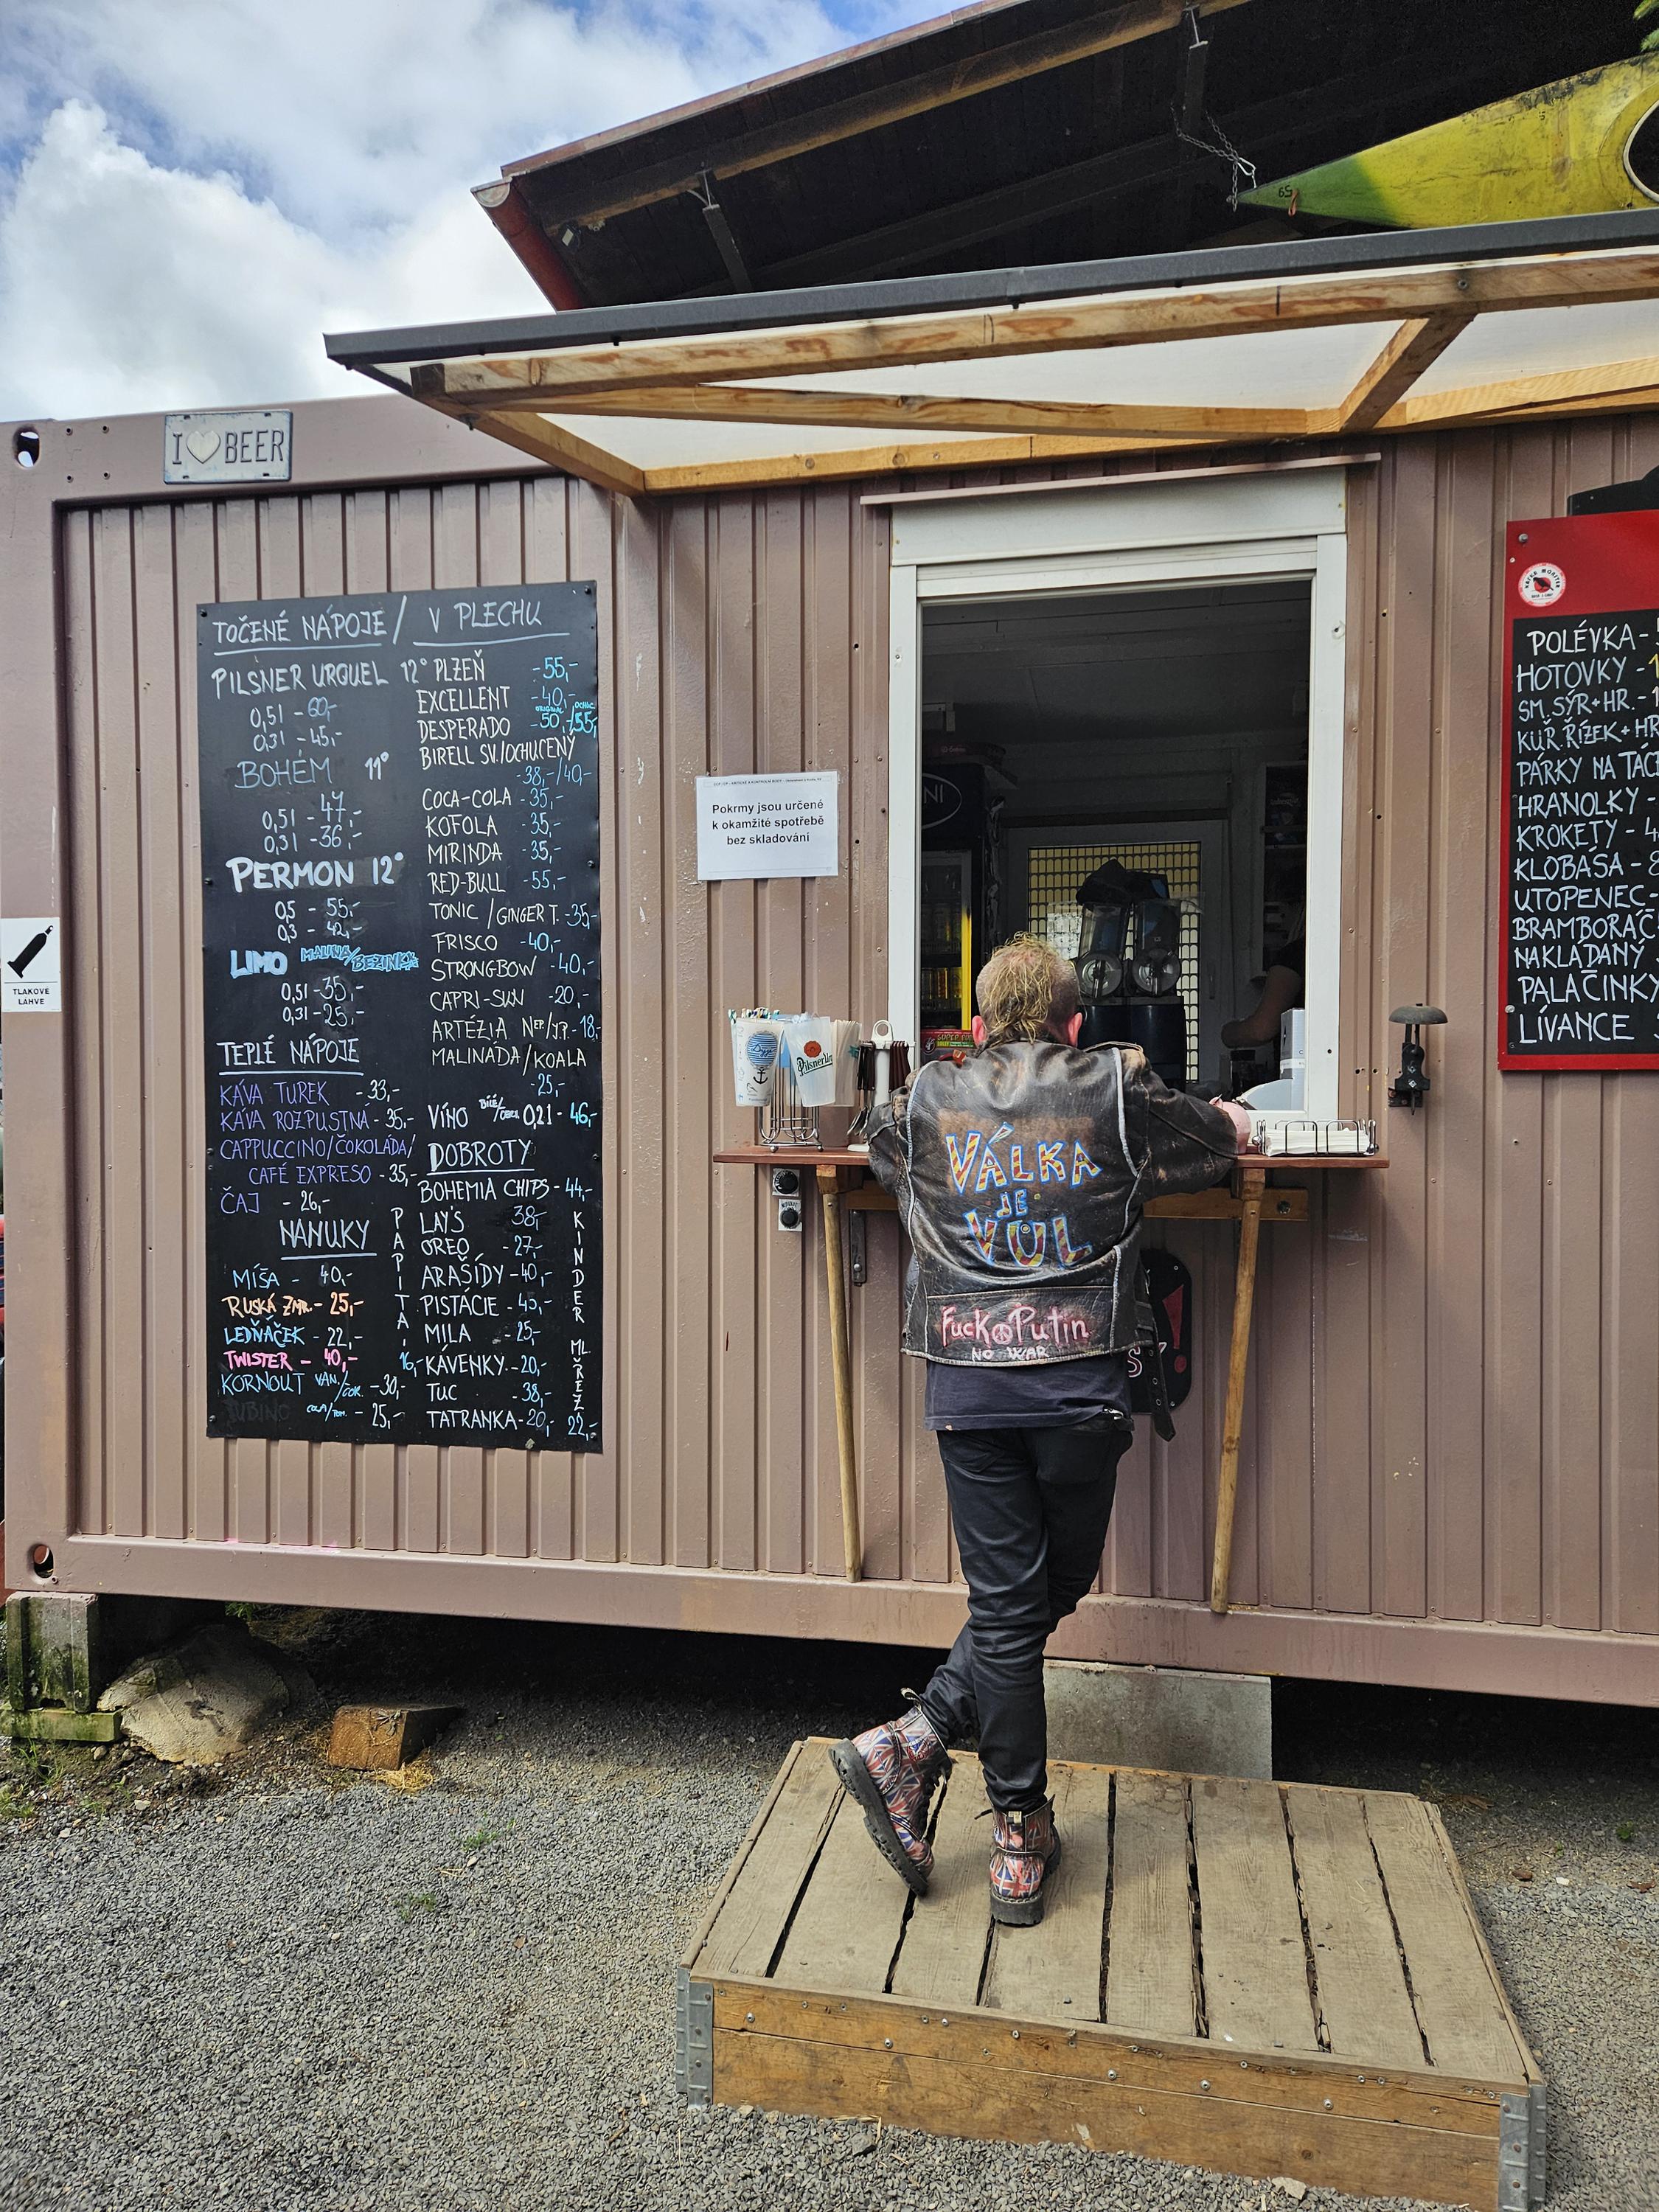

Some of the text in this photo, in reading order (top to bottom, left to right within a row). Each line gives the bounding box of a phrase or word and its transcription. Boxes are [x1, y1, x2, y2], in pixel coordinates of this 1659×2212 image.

[172, 428, 285, 465] I BEER
[212, 598, 542, 644] TOČENÉ NÁPOJE V PLECHU
[1526, 619, 1636, 656] POLÉVKA
[434, 649, 485, 682] PLZEŇ
[1517, 655, 1627, 693] HOTOVKY
[211, 663, 307, 700] PILSNER
[312, 661, 389, 687] URQUEL
[415, 686, 510, 714] EXCELLENT
[417, 716, 510, 743] DESPERADO
[419, 746, 475, 771] BIRELL
[1516, 752, 1582, 787] PÁRKY
[1593, 754, 1616, 780] NA
[422, 787, 512, 811] COCA-COLA
[712, 799, 824, 815] Pokrmy jsou určené
[1518, 786, 1639, 819] HRANOLKY
[425, 813, 498, 838] KOFOLA
[712, 815, 824, 830] k okamžité spotřebě
[1516, 818, 1618, 852] KROKETY
[727, 832, 810, 845] bez skladování
[428, 841, 503, 866] MIRINDA
[1514, 845, 1624, 883] KLOBÁSA
[226, 856, 354, 892] PERMON
[427, 872, 507, 896] RED-BULL
[428, 901, 479, 920] TONIC
[1514, 884, 1646, 913] UTOPENEC
[1512, 908, 1656, 941] BRAMBORÁČ
[431, 931, 498, 953] FRISCO
[1514, 937, 1646, 970] NAKLÁDANÝ
[230, 950, 288, 979] LIMO
[431, 955, 538, 981] STRONGBOW
[13, 986, 50, 995] TLAKOVÉ
[18, 996, 45, 1005] LÁHVE
[430, 988, 524, 1012] CAPRI-SUN
[432, 1014, 508, 1043] ARTÉZIA
[1519, 1004, 1635, 1043] LÍVANCE
[216, 1032, 360, 1066] TEPLÉ NÁPOJE
[796, 1056, 824, 1077] Pilsner
[220, 1078, 330, 1107] KÁVA TUREK
[220, 1103, 370, 1132] KÁVA ROZPUSTNÁ
[428, 1102, 468, 1130] VÍNO
[428, 1138, 534, 1172] DOBROTY
[945, 1121, 1103, 1196] VÁLKA
[248, 1161, 372, 1185] CAFÉ EXPRESO
[220, 1186, 260, 1214] ČAJ
[417, 1177, 550, 1203] BOHEMIA CHIPS
[995, 1188, 1028, 1220] JE
[279, 1218, 370, 1251] NANUKY
[420, 1237, 470, 1256] OREO
[232, 1262, 280, 1290] MÍŠA
[421, 1253, 504, 1290] ARAŠÍDY
[221, 1292, 277, 1319] RUSKÁ
[419, 1287, 500, 1317] PISTÁCIE
[223, 1315, 305, 1348] LEDŇÁČEK
[424, 1323, 472, 1343] MILA
[941, 1304, 1092, 1348] Fuck Putin
[223, 1349, 293, 1372] TWISTER
[972, 1345, 1050, 1362] NO WAR
[220, 1372, 305, 1396] KORNOUT
[425, 1382, 457, 1402] TUC
[425, 1410, 518, 1430] TATRANKA
